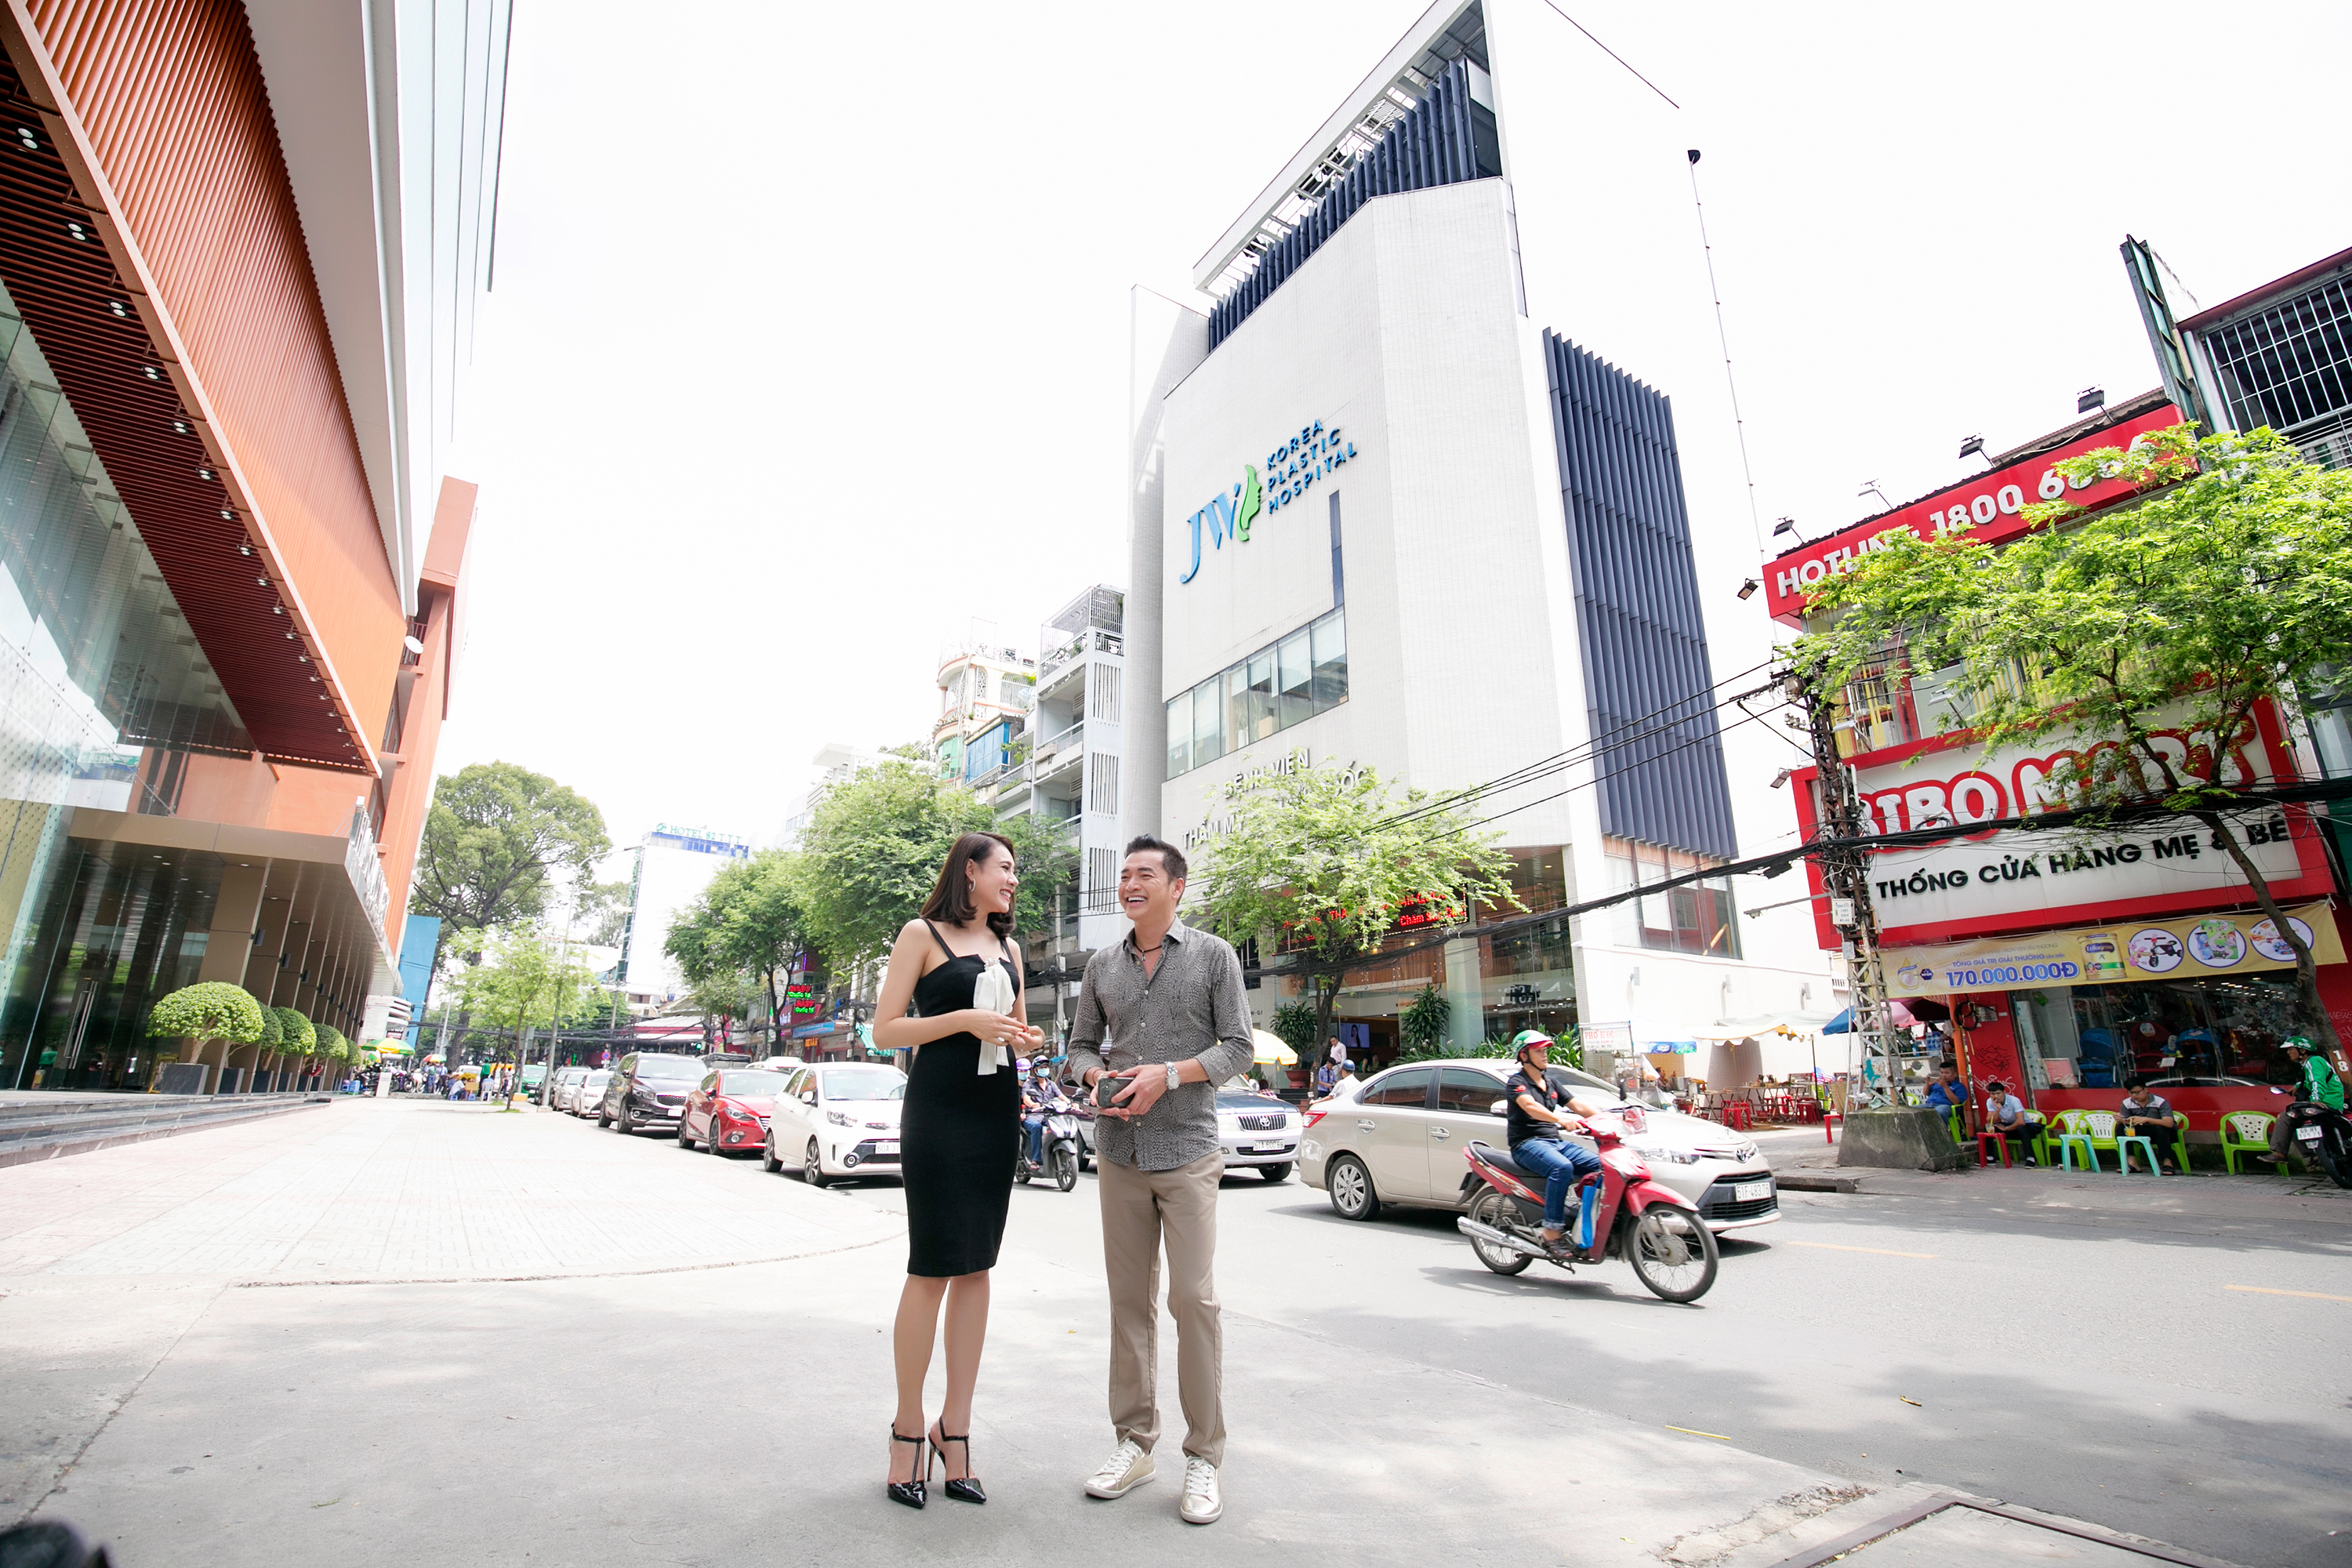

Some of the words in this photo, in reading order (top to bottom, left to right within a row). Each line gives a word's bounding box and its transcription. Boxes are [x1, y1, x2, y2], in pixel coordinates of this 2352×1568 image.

[1267, 419, 1323, 470] KOREA
[1268, 428, 1341, 492] PLASTIC
[1268, 441, 1357, 514] HOSPITAL
[1929, 484, 2024, 539] 1800
[670, 826, 703, 839] HOTEL
[706, 832, 717, 840] 82
[1876, 867, 1969, 898] THỐNG
[1979, 855, 2040, 883] CỬA
[2049, 842, 2142, 874] HÀNG
[2152, 834, 2201, 860] MẸ
[1945, 961, 2079, 988] 170.000.000Đ
